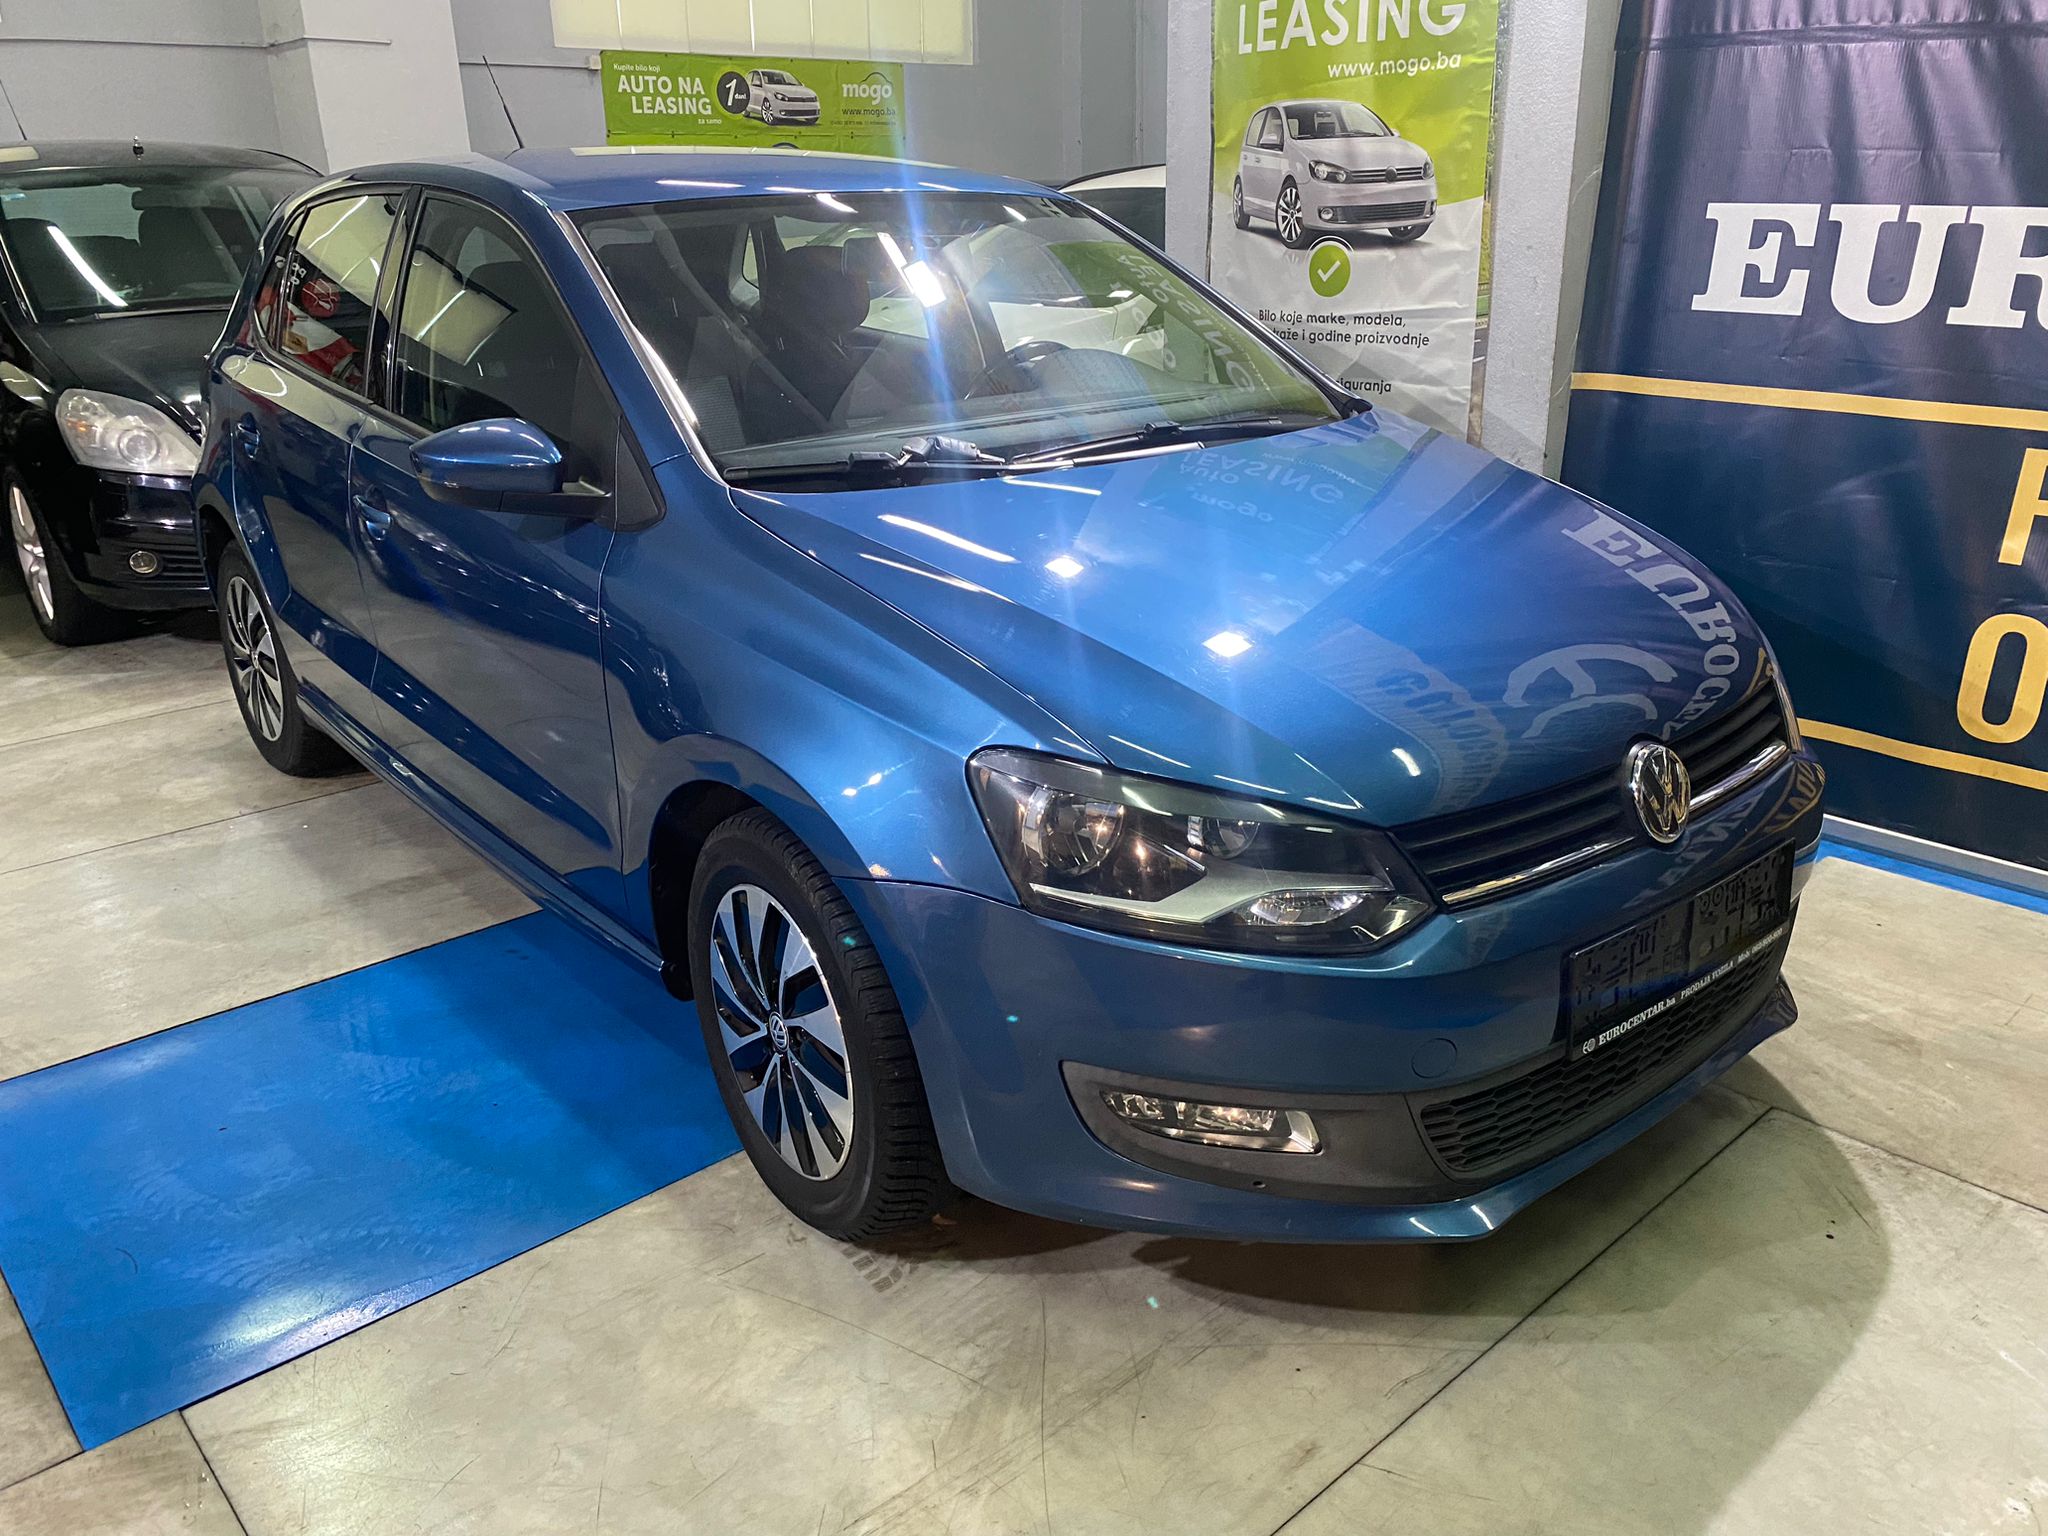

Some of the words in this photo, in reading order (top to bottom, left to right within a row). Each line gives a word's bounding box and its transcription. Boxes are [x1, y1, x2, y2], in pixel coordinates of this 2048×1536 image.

[1238, 0, 1466, 55] LEASING
[1327, 52, 1462, 78] www.mogo.ba
[618, 75, 672, 94] AUTO
[678, 77, 706, 95] NA
[725, 78, 737, 106] 1
[842, 83, 893, 105] mogo
[631, 96, 712, 115] LEASING
[842, 107, 897, 117] www.mogo.ba
[1258, 309, 1277, 322] Bilo
[1279, 310, 1303, 325] koje
[1306, 312, 1350, 326] marke,
[1353, 313, 1407, 328] modela,
[1309, 329, 1352, 345] godine
[1354, 332, 1430, 348] proizvodnje
